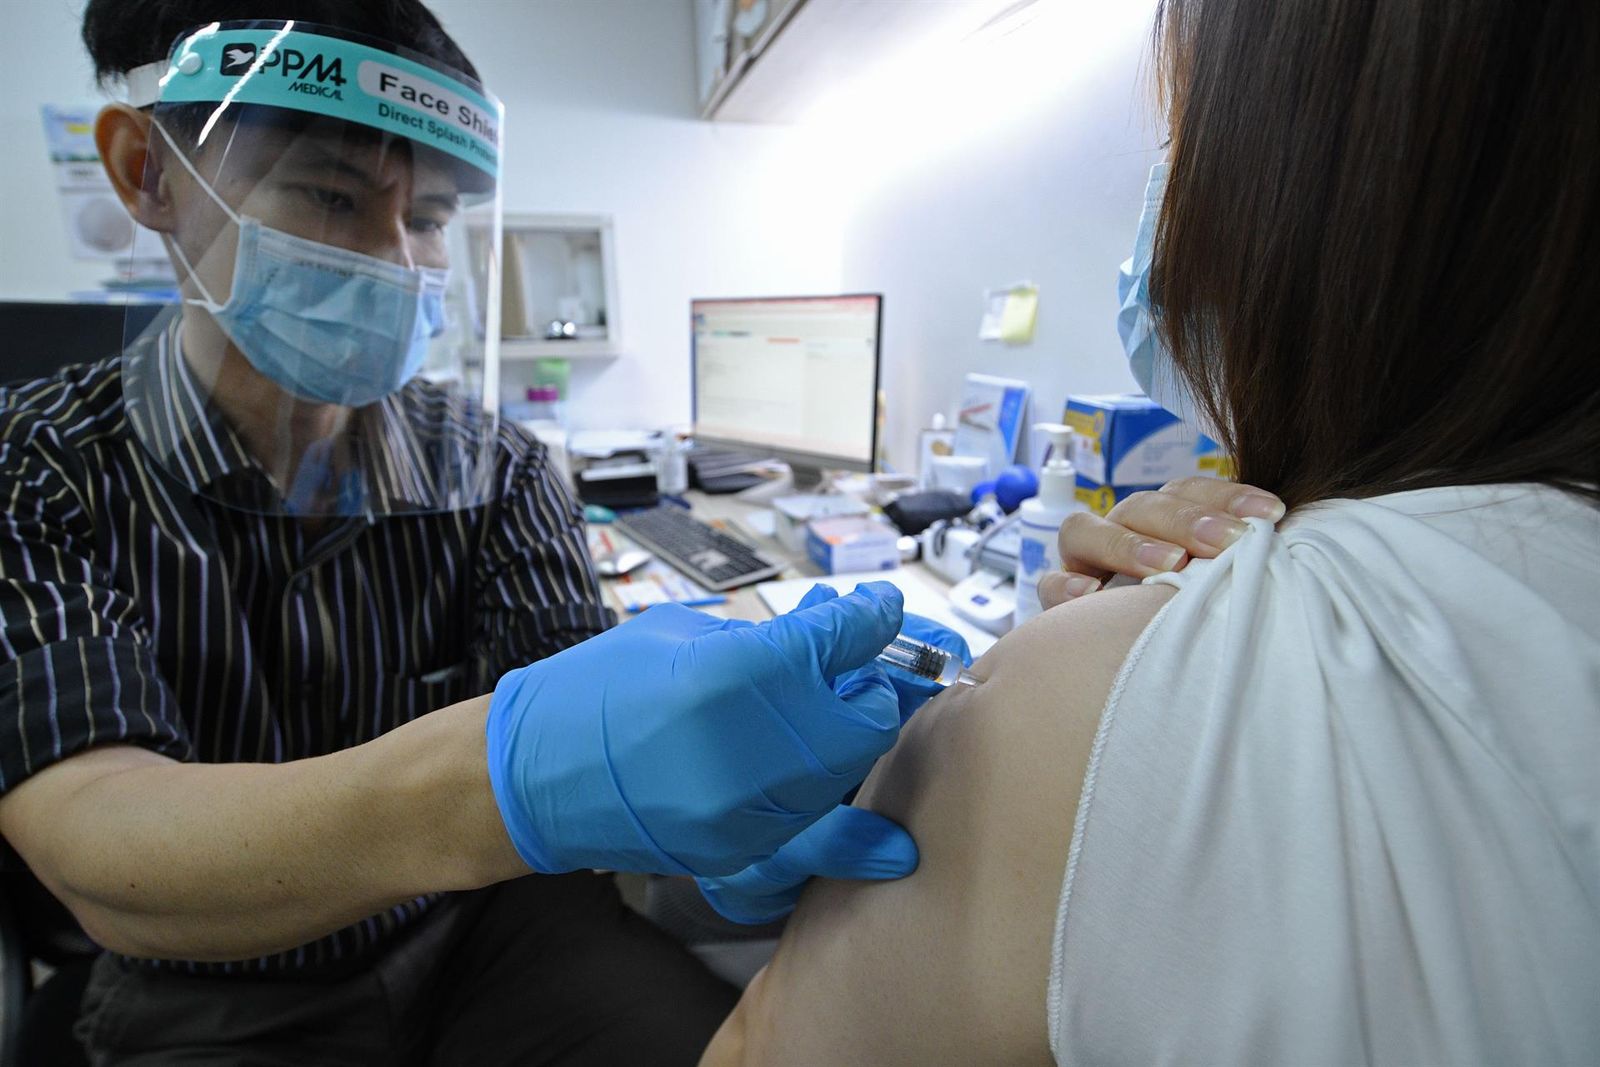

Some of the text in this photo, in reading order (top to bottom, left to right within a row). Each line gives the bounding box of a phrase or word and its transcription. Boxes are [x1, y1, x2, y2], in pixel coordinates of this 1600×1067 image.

[288, 81, 344, 101] MEDICAL
[379, 72, 449, 115] Face
[378, 102, 424, 129] Direct
[427, 120, 468, 148] Splash
